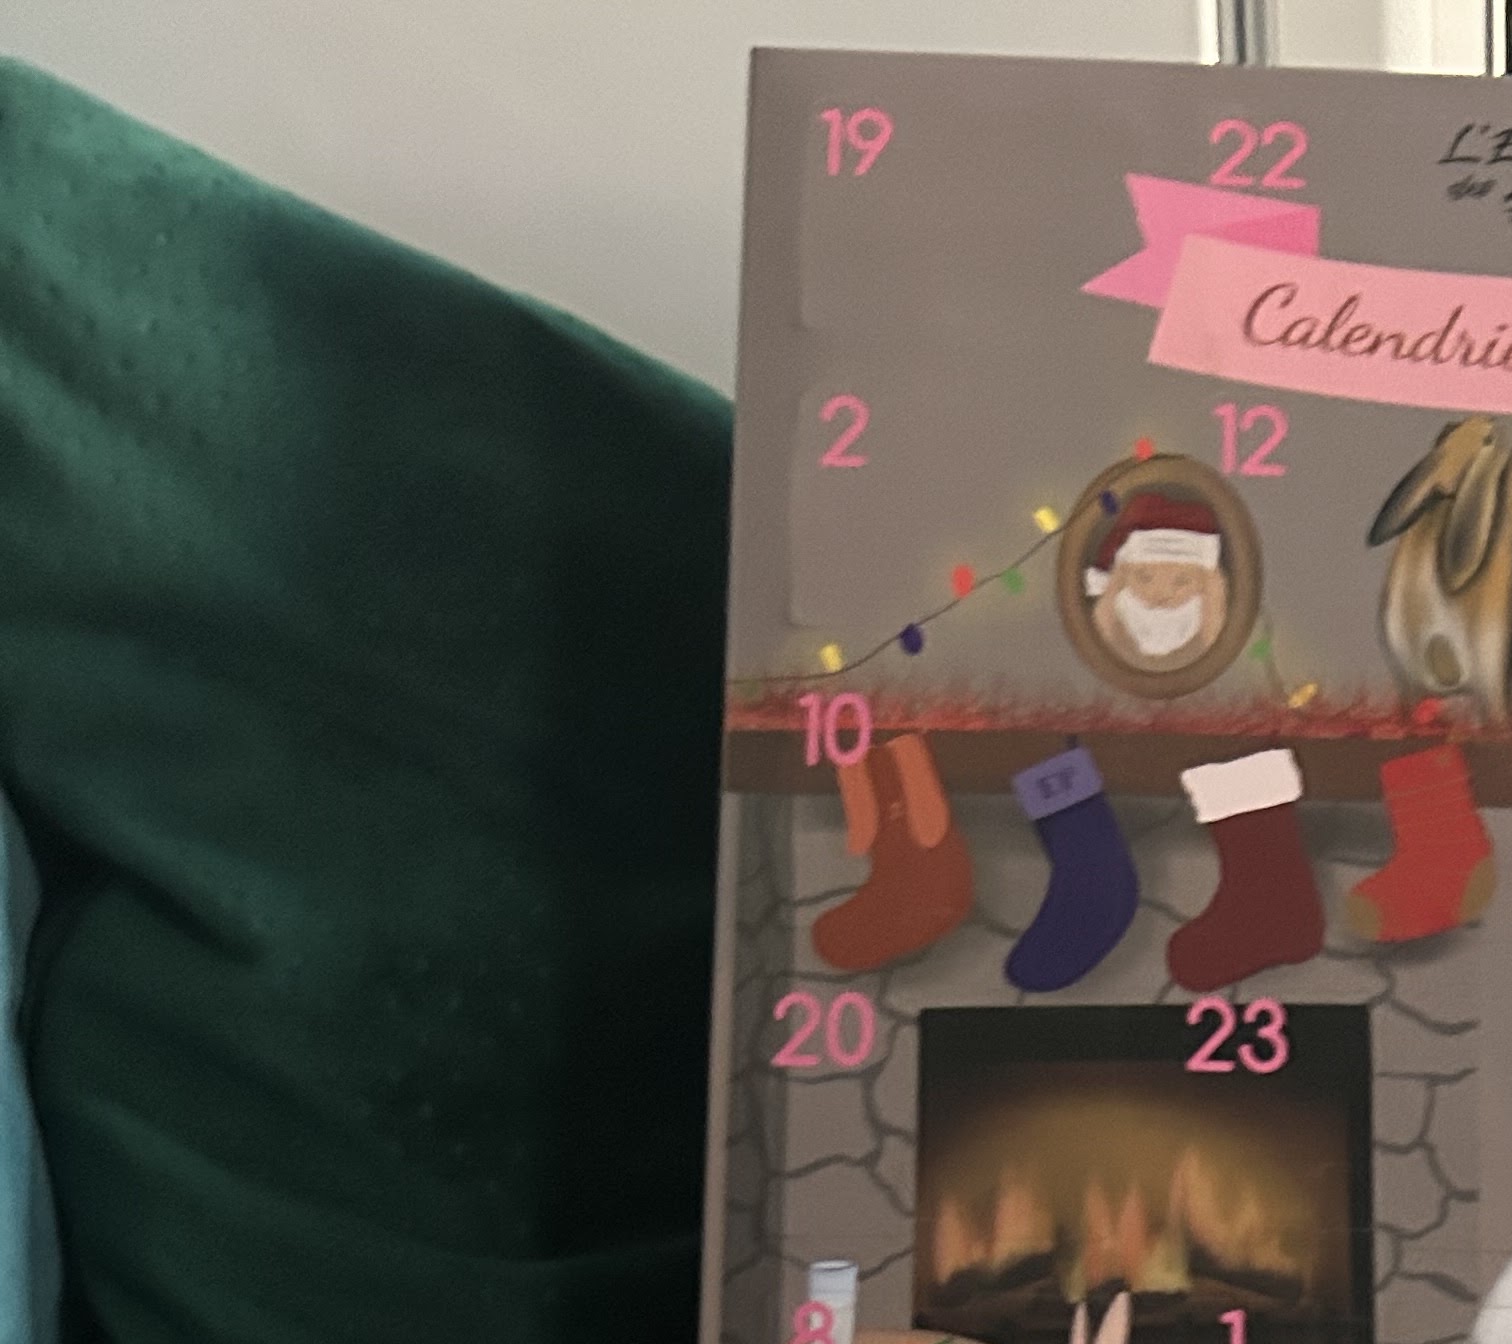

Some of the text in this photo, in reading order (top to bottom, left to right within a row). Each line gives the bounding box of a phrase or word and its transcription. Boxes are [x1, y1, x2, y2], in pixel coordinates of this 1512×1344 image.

[821, 107, 894, 176] 19
[1209, 119, 1308, 190] 22
[820, 395, 870, 467] 2
[1214, 404, 1289, 477] 12
[798, 693, 872, 767] 10
[772, 992, 874, 1068] 20
[1187, 999, 1289, 1073] 23
